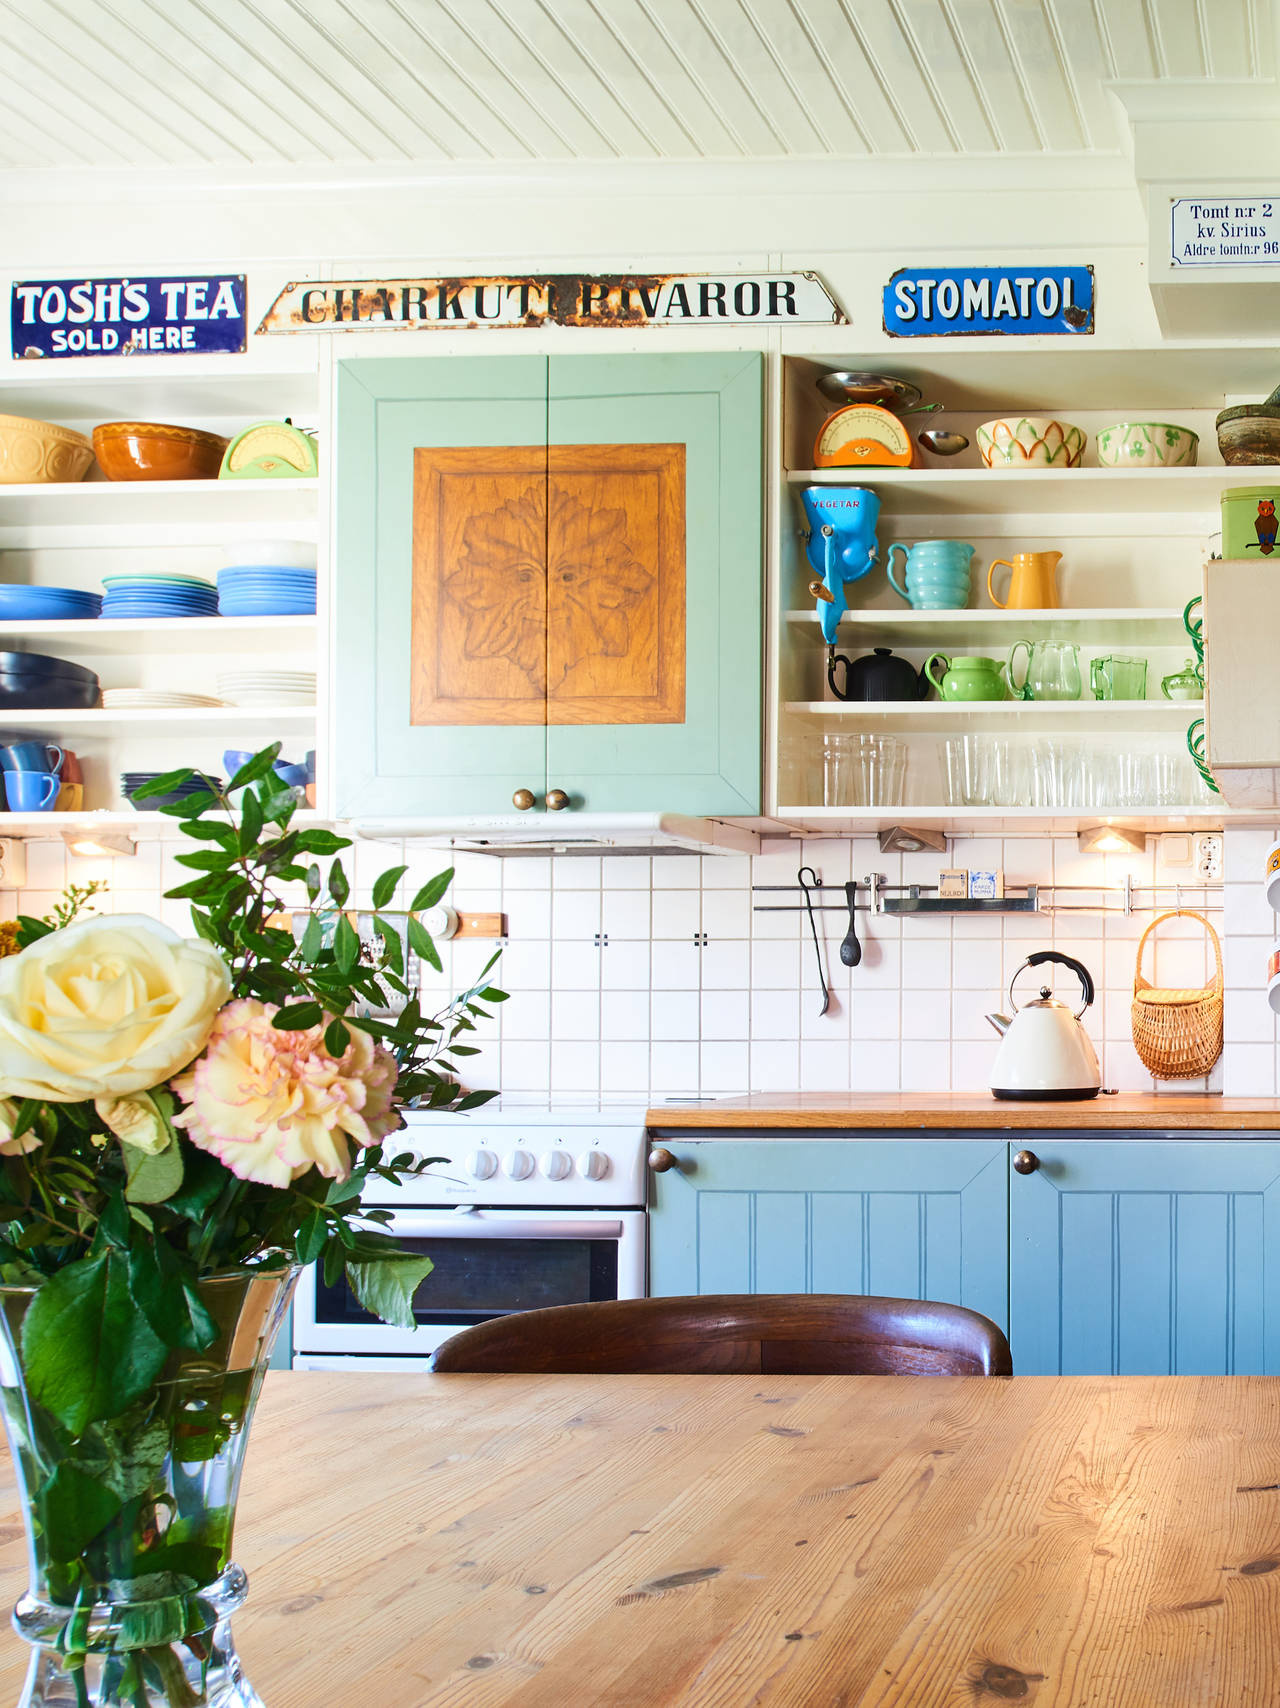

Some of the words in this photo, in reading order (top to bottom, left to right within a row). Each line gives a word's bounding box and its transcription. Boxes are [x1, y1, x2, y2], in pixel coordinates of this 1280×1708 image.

[1191, 204, 1229, 219] Tomt
[1262, 203, 1273, 217] 2
[1197, 224, 1215, 238] kv.
[1221, 222, 1267, 238] Sirius
[1263, 241, 1279, 254] 96
[17, 281, 150, 324] TOSH'S
[161, 281, 241, 320] TEA
[51, 328, 119, 352] SOLD
[133, 326, 196, 351] HERE
[812, 500, 860, 508] VEGETAR
